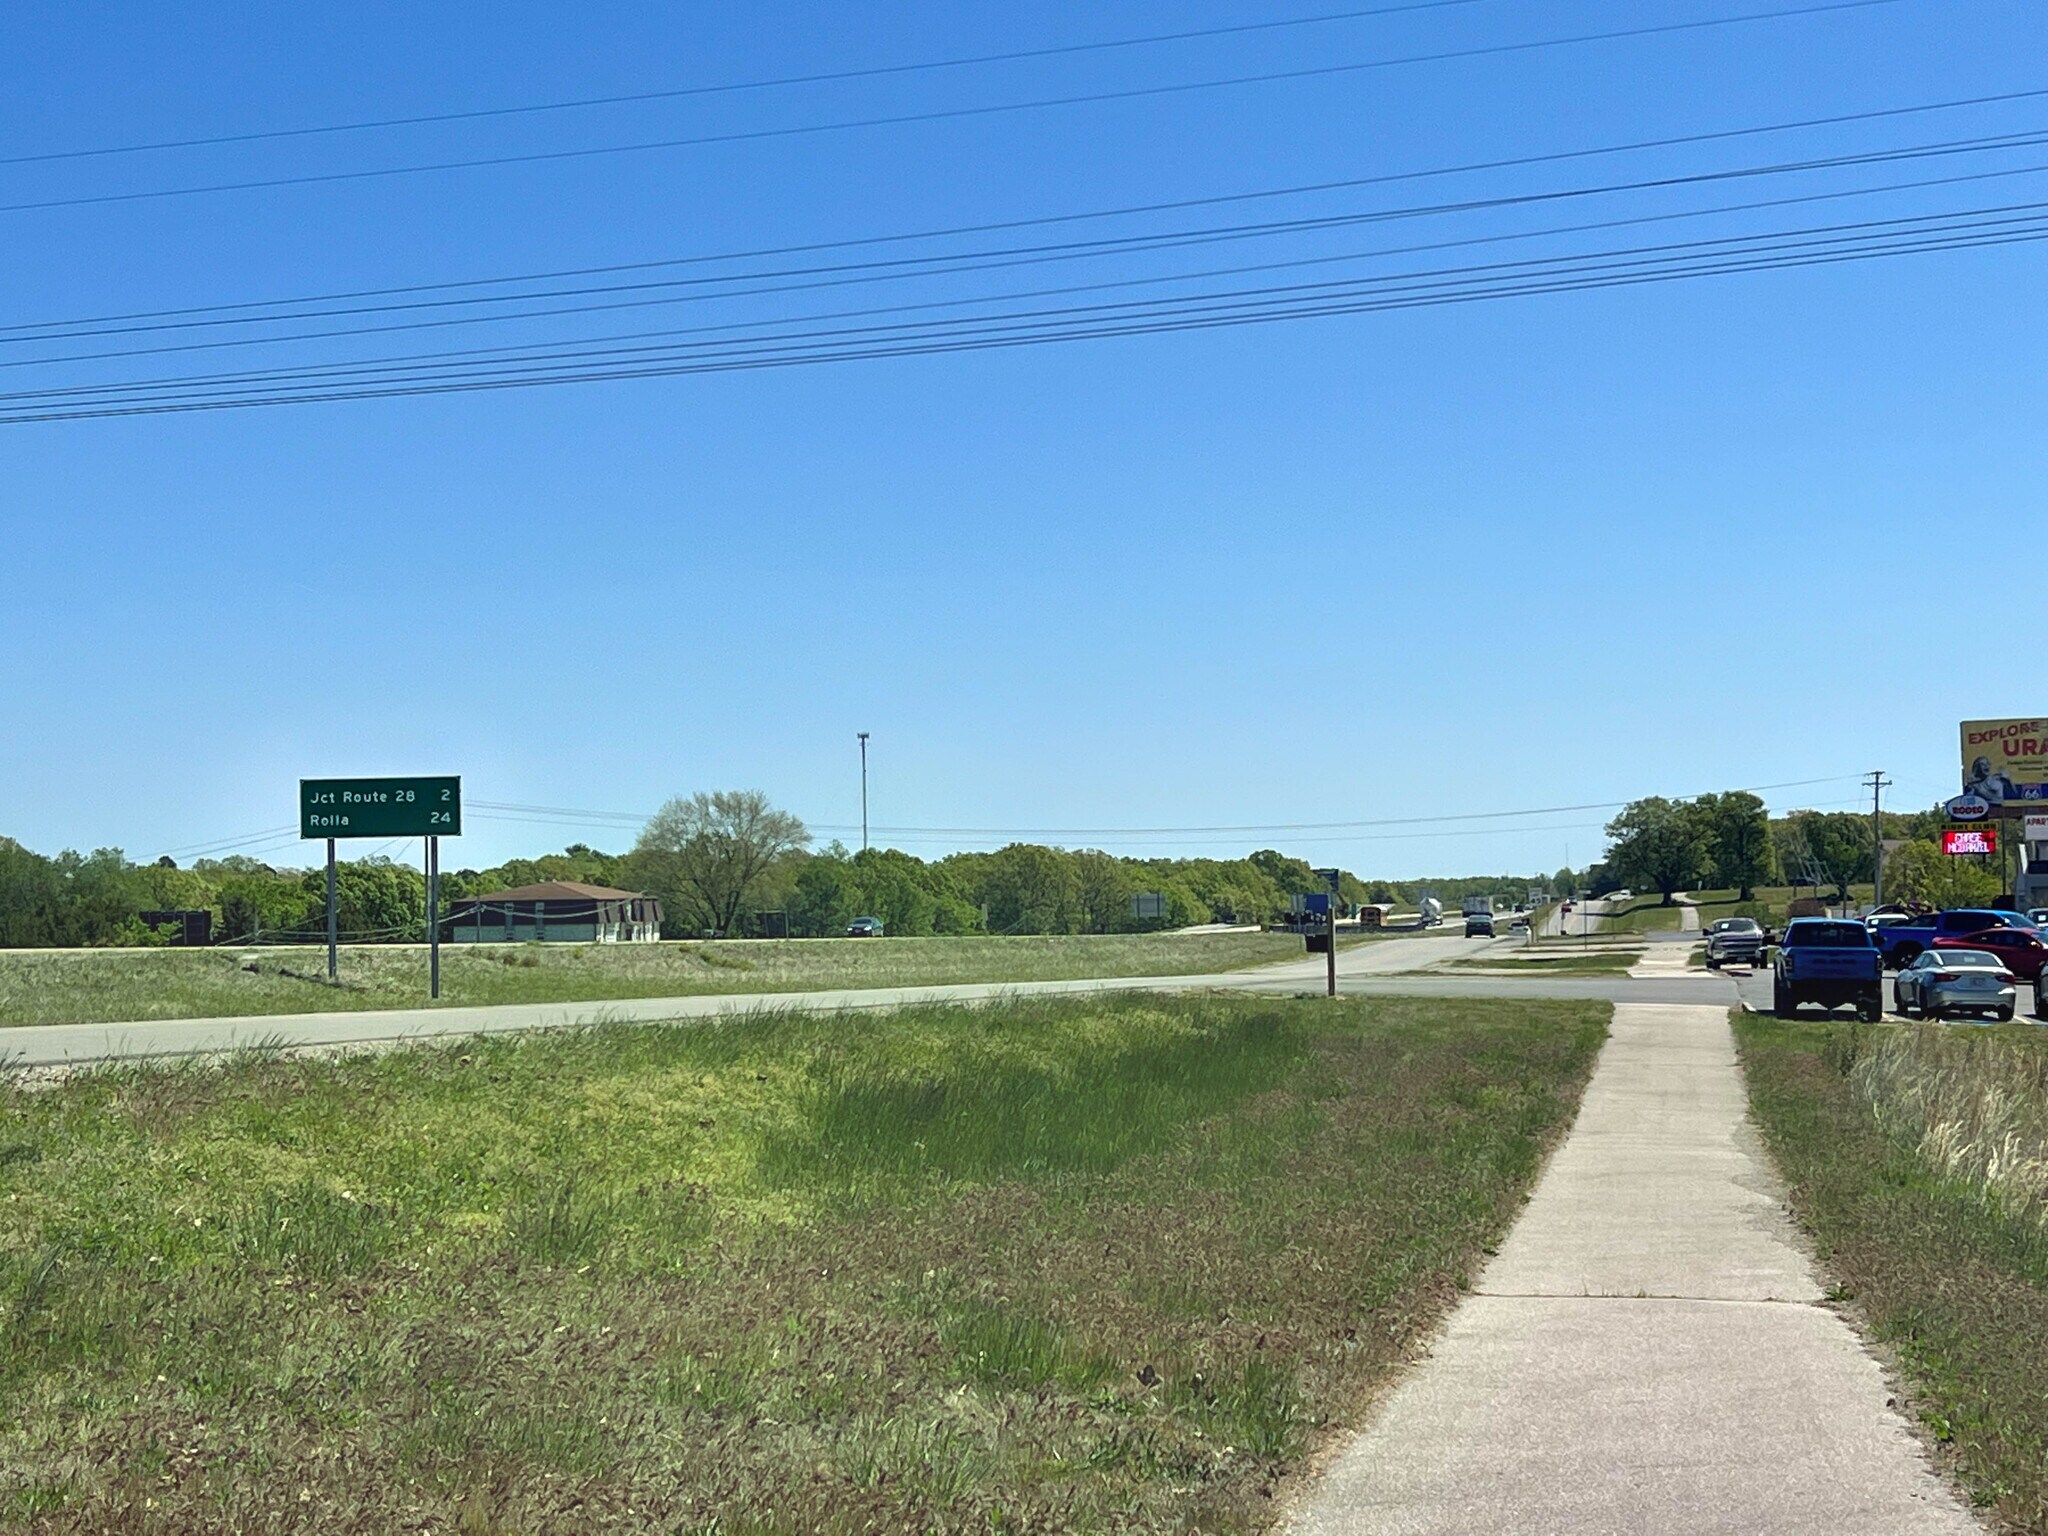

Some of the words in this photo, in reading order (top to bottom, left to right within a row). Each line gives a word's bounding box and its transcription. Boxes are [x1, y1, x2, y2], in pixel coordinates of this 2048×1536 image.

[1968, 721, 2039, 745] EXPLORE
[310, 792, 335, 804] Jct
[343, 791, 388, 803] Route
[395, 790, 415, 802] 28
[441, 789, 451, 801] 2
[2024, 790, 2040, 799] 66
[1952, 806, 1984, 814] RODEO
[310, 814, 349, 826] Rolla
[430, 811, 451, 823] 24
